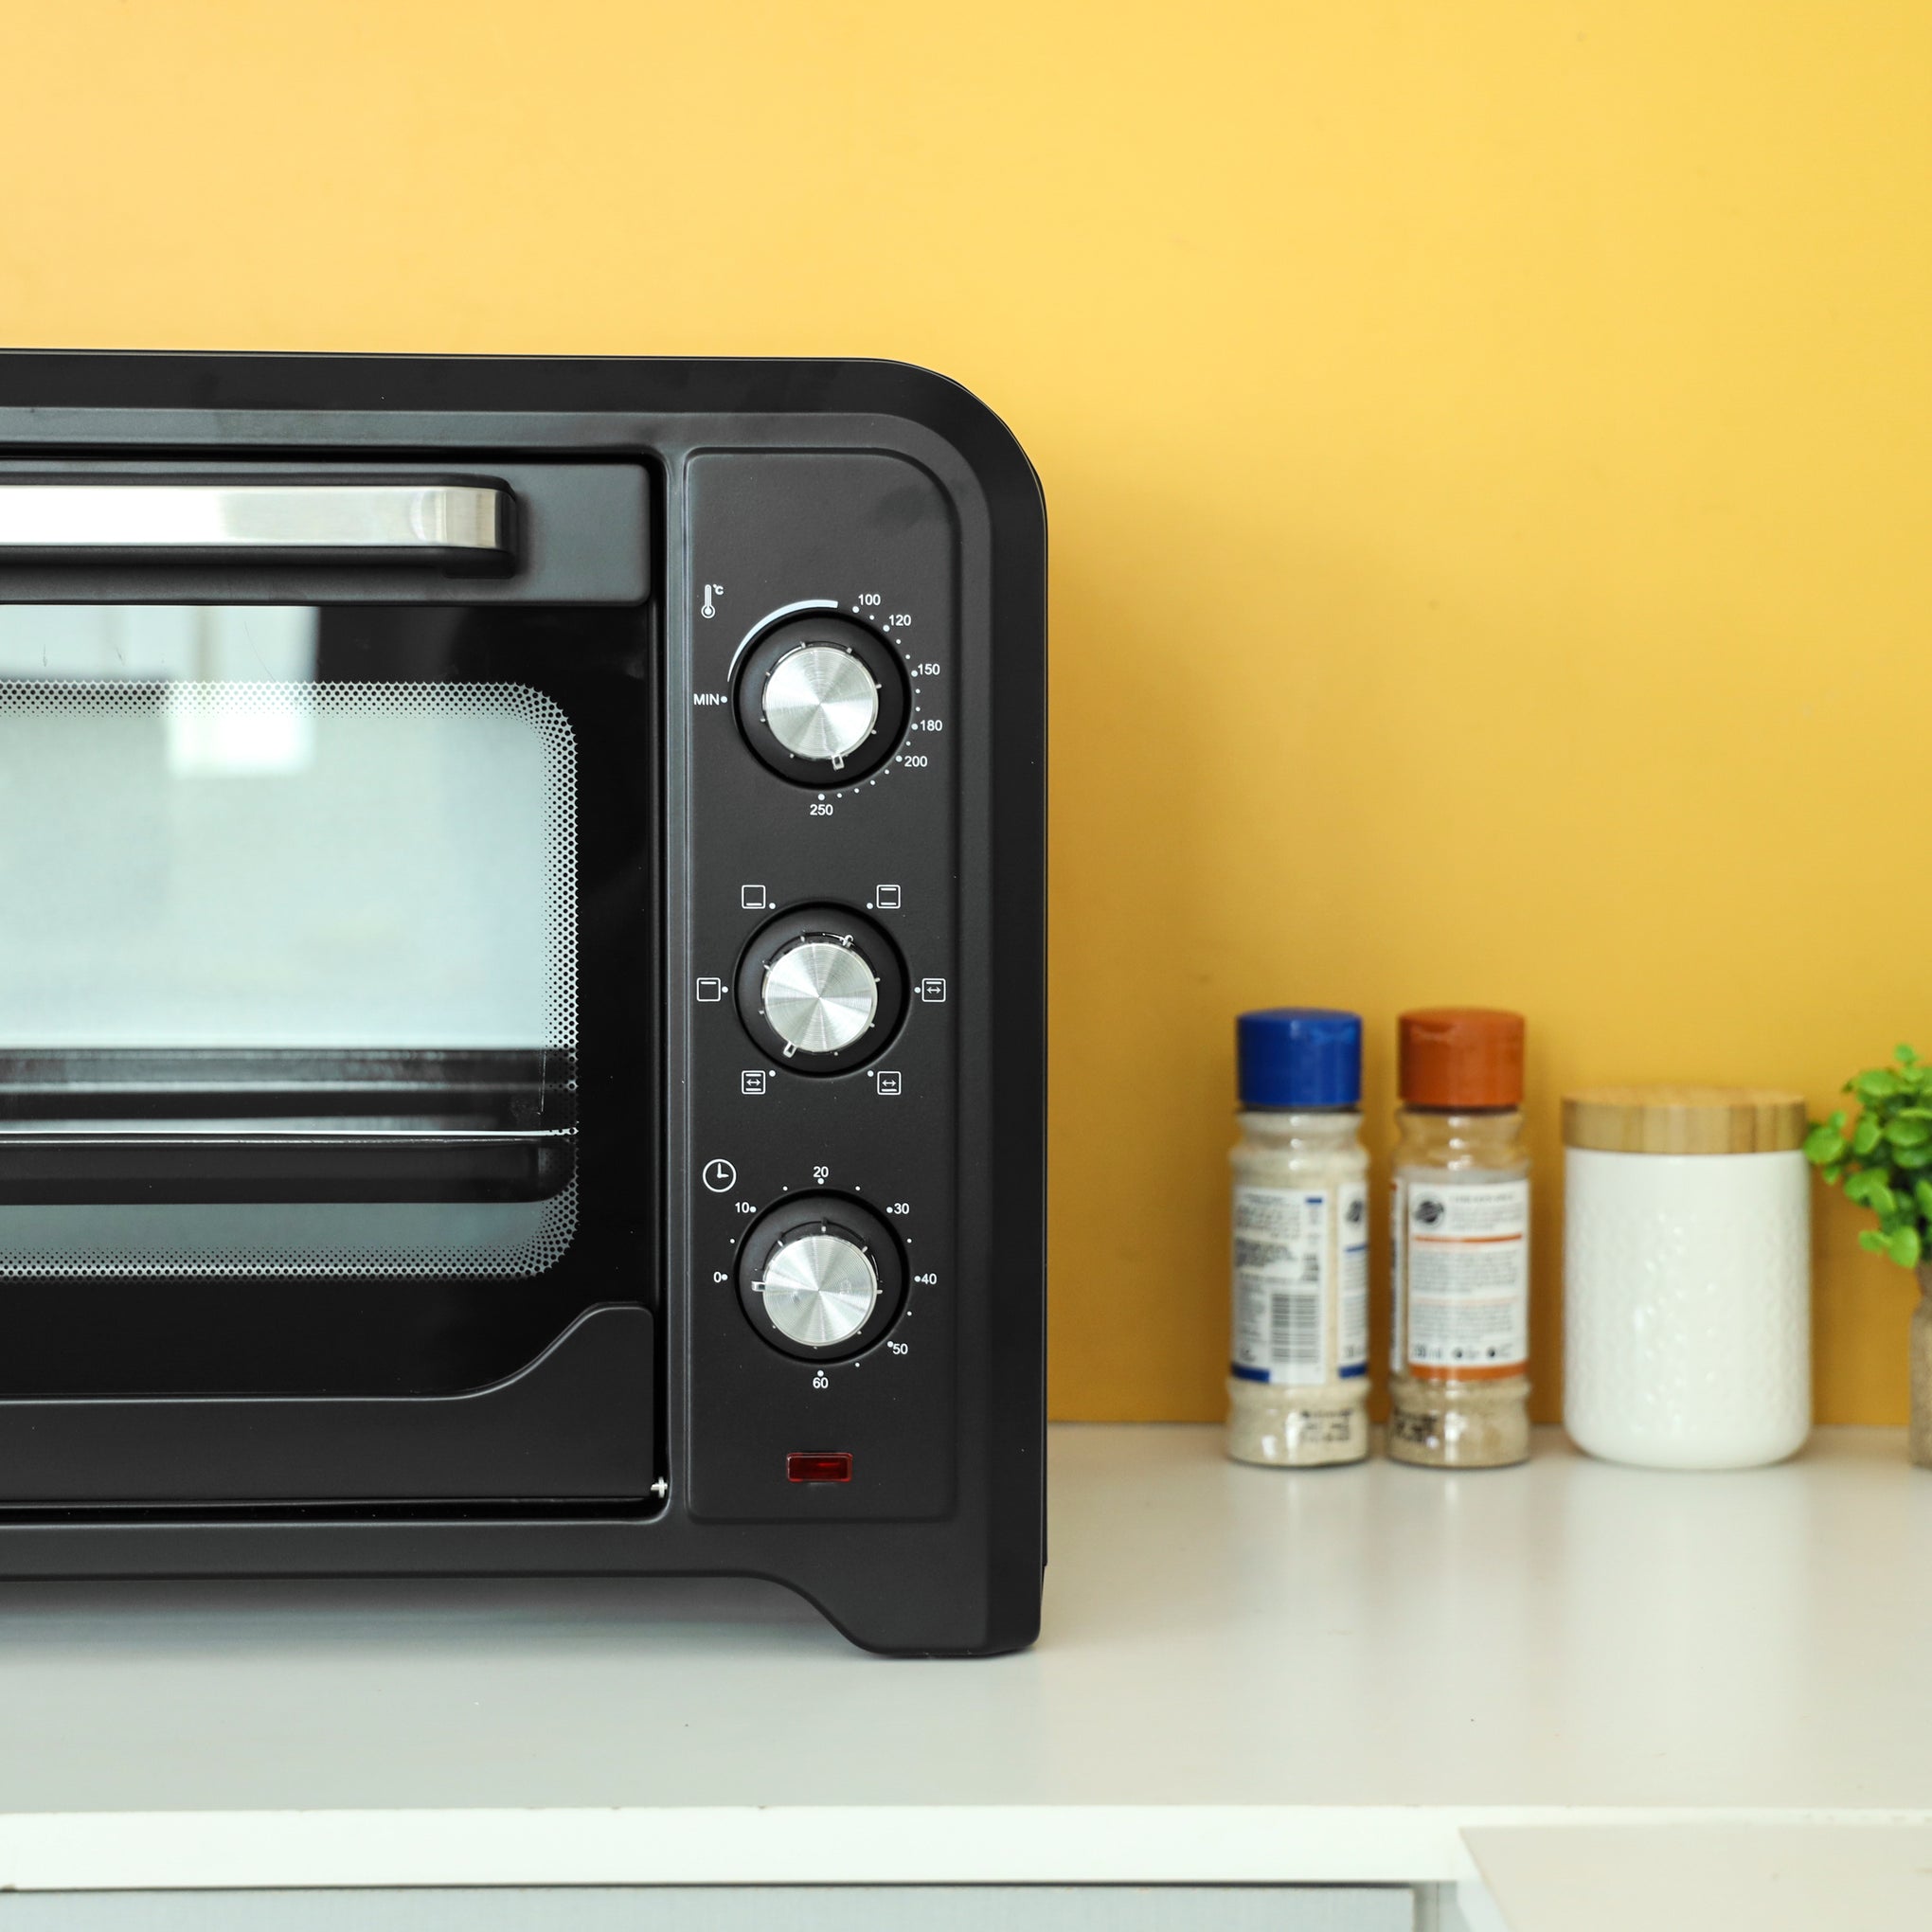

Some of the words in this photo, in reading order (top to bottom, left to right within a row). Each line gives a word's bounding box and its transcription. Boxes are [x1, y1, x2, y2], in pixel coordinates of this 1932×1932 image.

[713, 583, 724, 596] °C
[858, 594, 881, 606] 100
[888, 615, 911, 627] 120
[918, 664, 940, 675] 150
[693, 694, 720, 706] MIN
[920, 720, 942, 732] 180
[903, 757, 928, 768] 200
[810, 804, 833, 816] 250
[813, 1166, 829, 1178] 20
[735, 1202, 750, 1214] 10
[893, 1203, 910, 1215] 30
[713, 1272, 722, 1283] 0
[921, 1274, 938, 1285] 40
[892, 1343, 908, 1355] 50
[813, 1378, 829, 1389] 60
